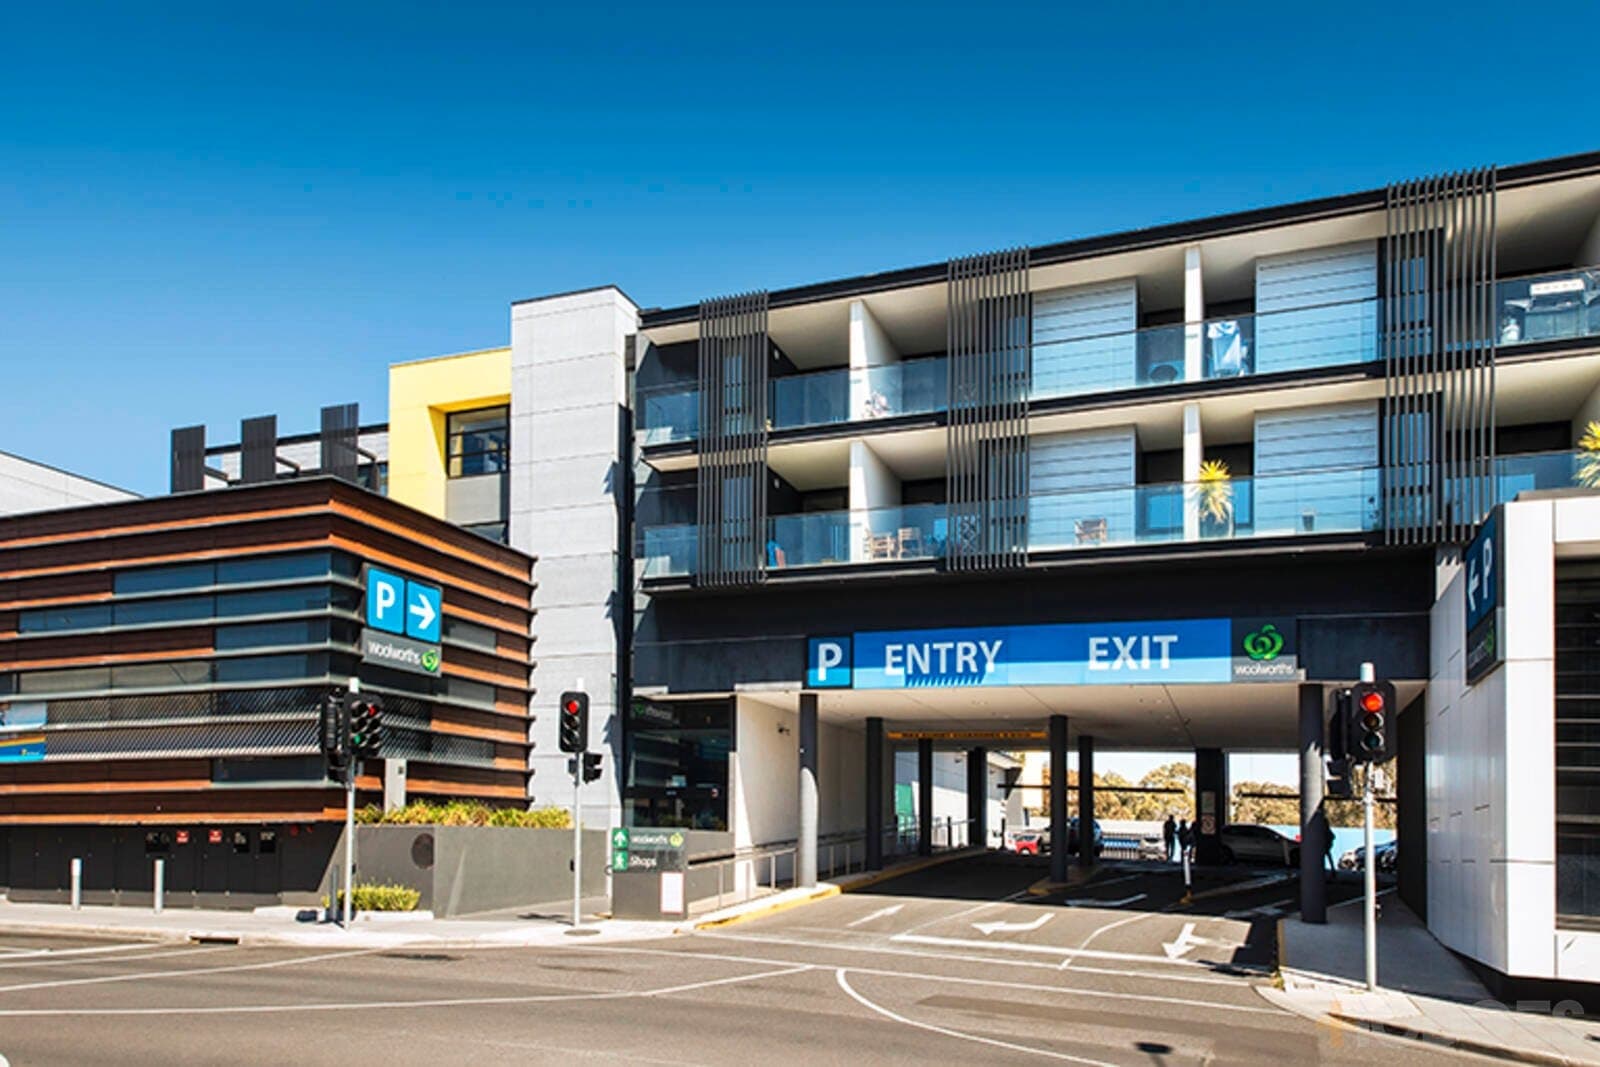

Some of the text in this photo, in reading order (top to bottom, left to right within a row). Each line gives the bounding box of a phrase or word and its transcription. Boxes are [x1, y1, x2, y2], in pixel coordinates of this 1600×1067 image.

[1483, 536, 1493, 600] P
[376, 581, 396, 620] P
[817, 642, 843, 682] P
[884, 634, 1179, 677] ENTRY EXIT
